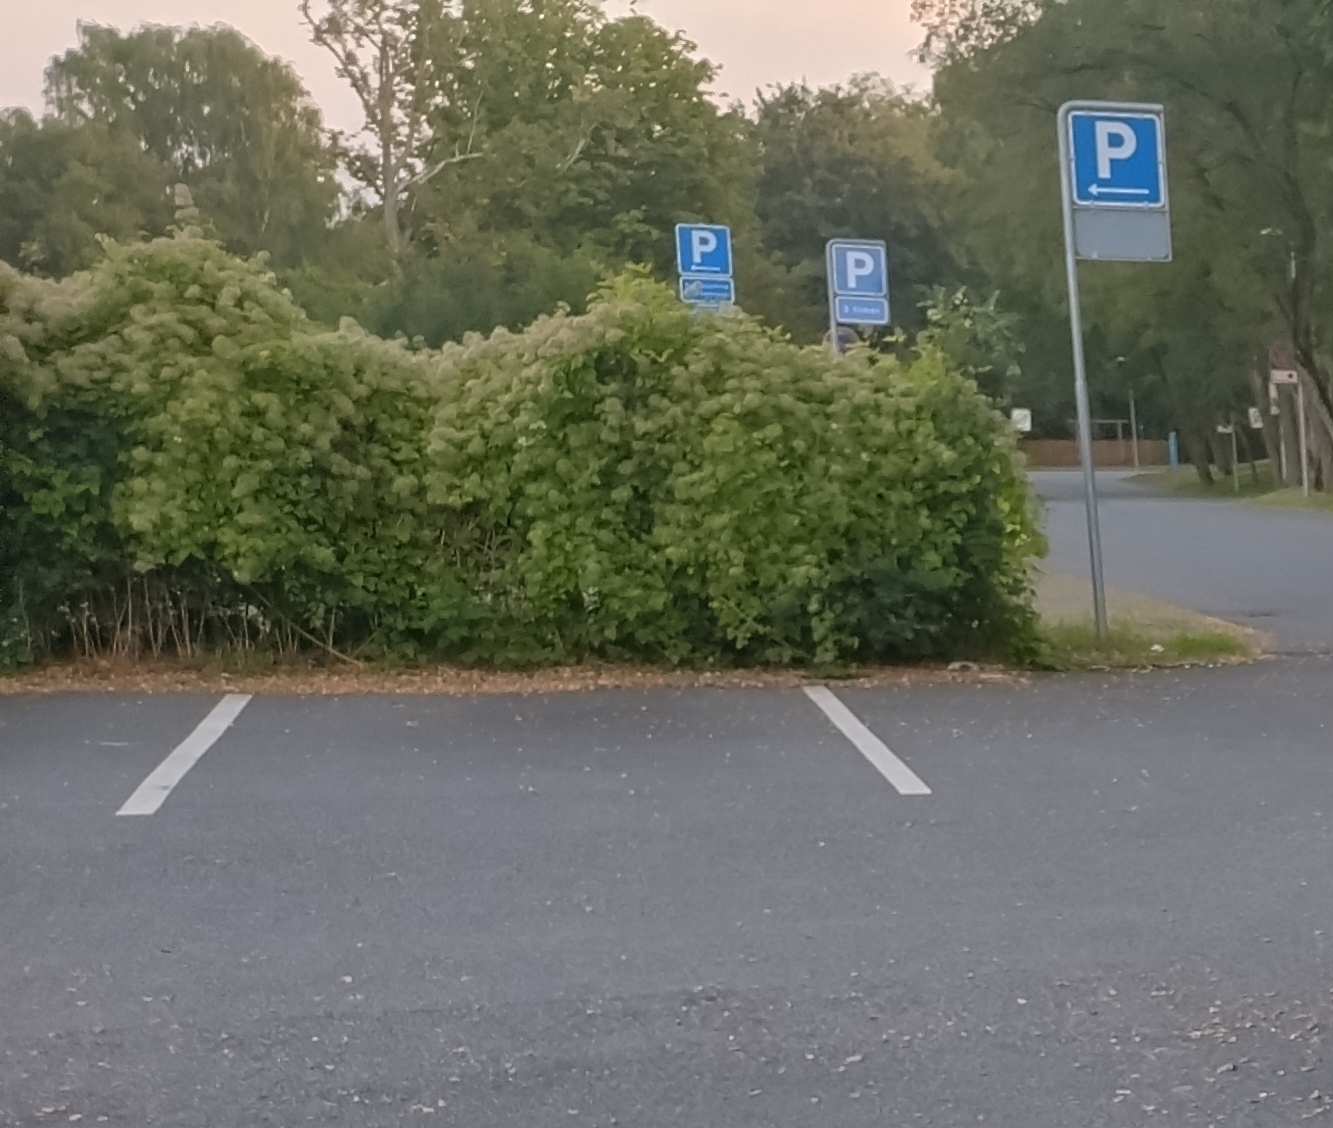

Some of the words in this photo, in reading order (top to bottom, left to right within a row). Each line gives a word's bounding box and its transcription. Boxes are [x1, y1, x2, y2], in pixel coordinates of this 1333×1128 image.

[1095, 120, 1137, 179] P
[691, 229, 717, 264] P
[846, 250, 875, 289] P
